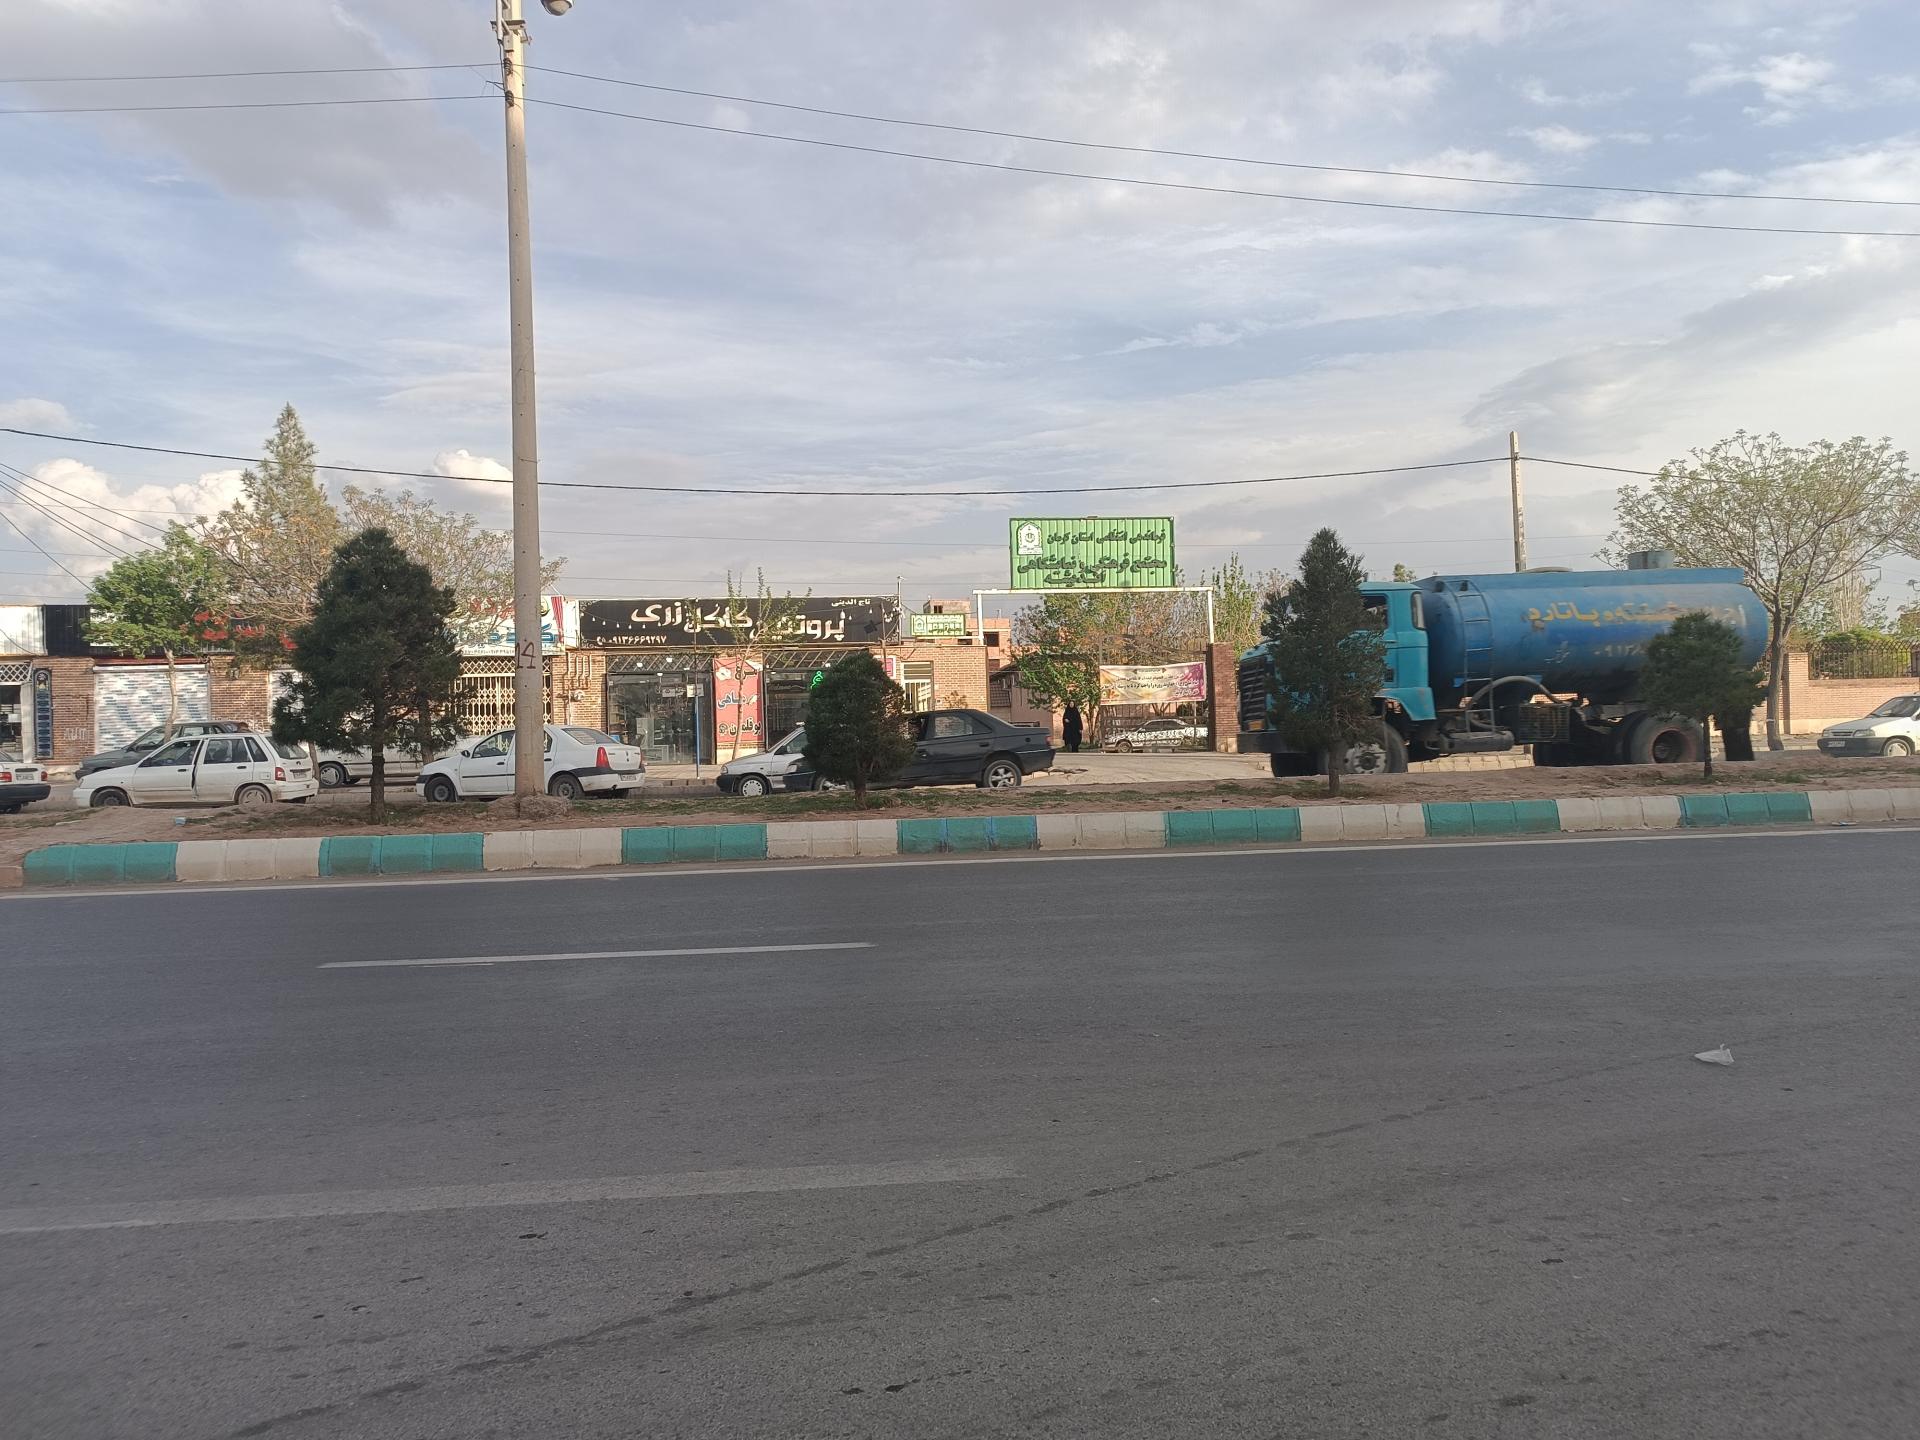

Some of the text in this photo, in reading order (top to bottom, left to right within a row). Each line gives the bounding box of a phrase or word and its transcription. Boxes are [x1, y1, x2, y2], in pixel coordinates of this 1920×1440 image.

[1047, 529, 1167, 545] فرماندهی انتظامی استان کرمان
[1017, 554, 1077, 574] نمایشگاهی
[1091, 552, 1130, 574] فرهنگی
[1129, 556, 1168, 575] مجتمع
[831, 599, 871, 608] تاج الدینی
[734, 663, 758, 681] مرغ
[729, 717, 762, 736] بوقلمن
